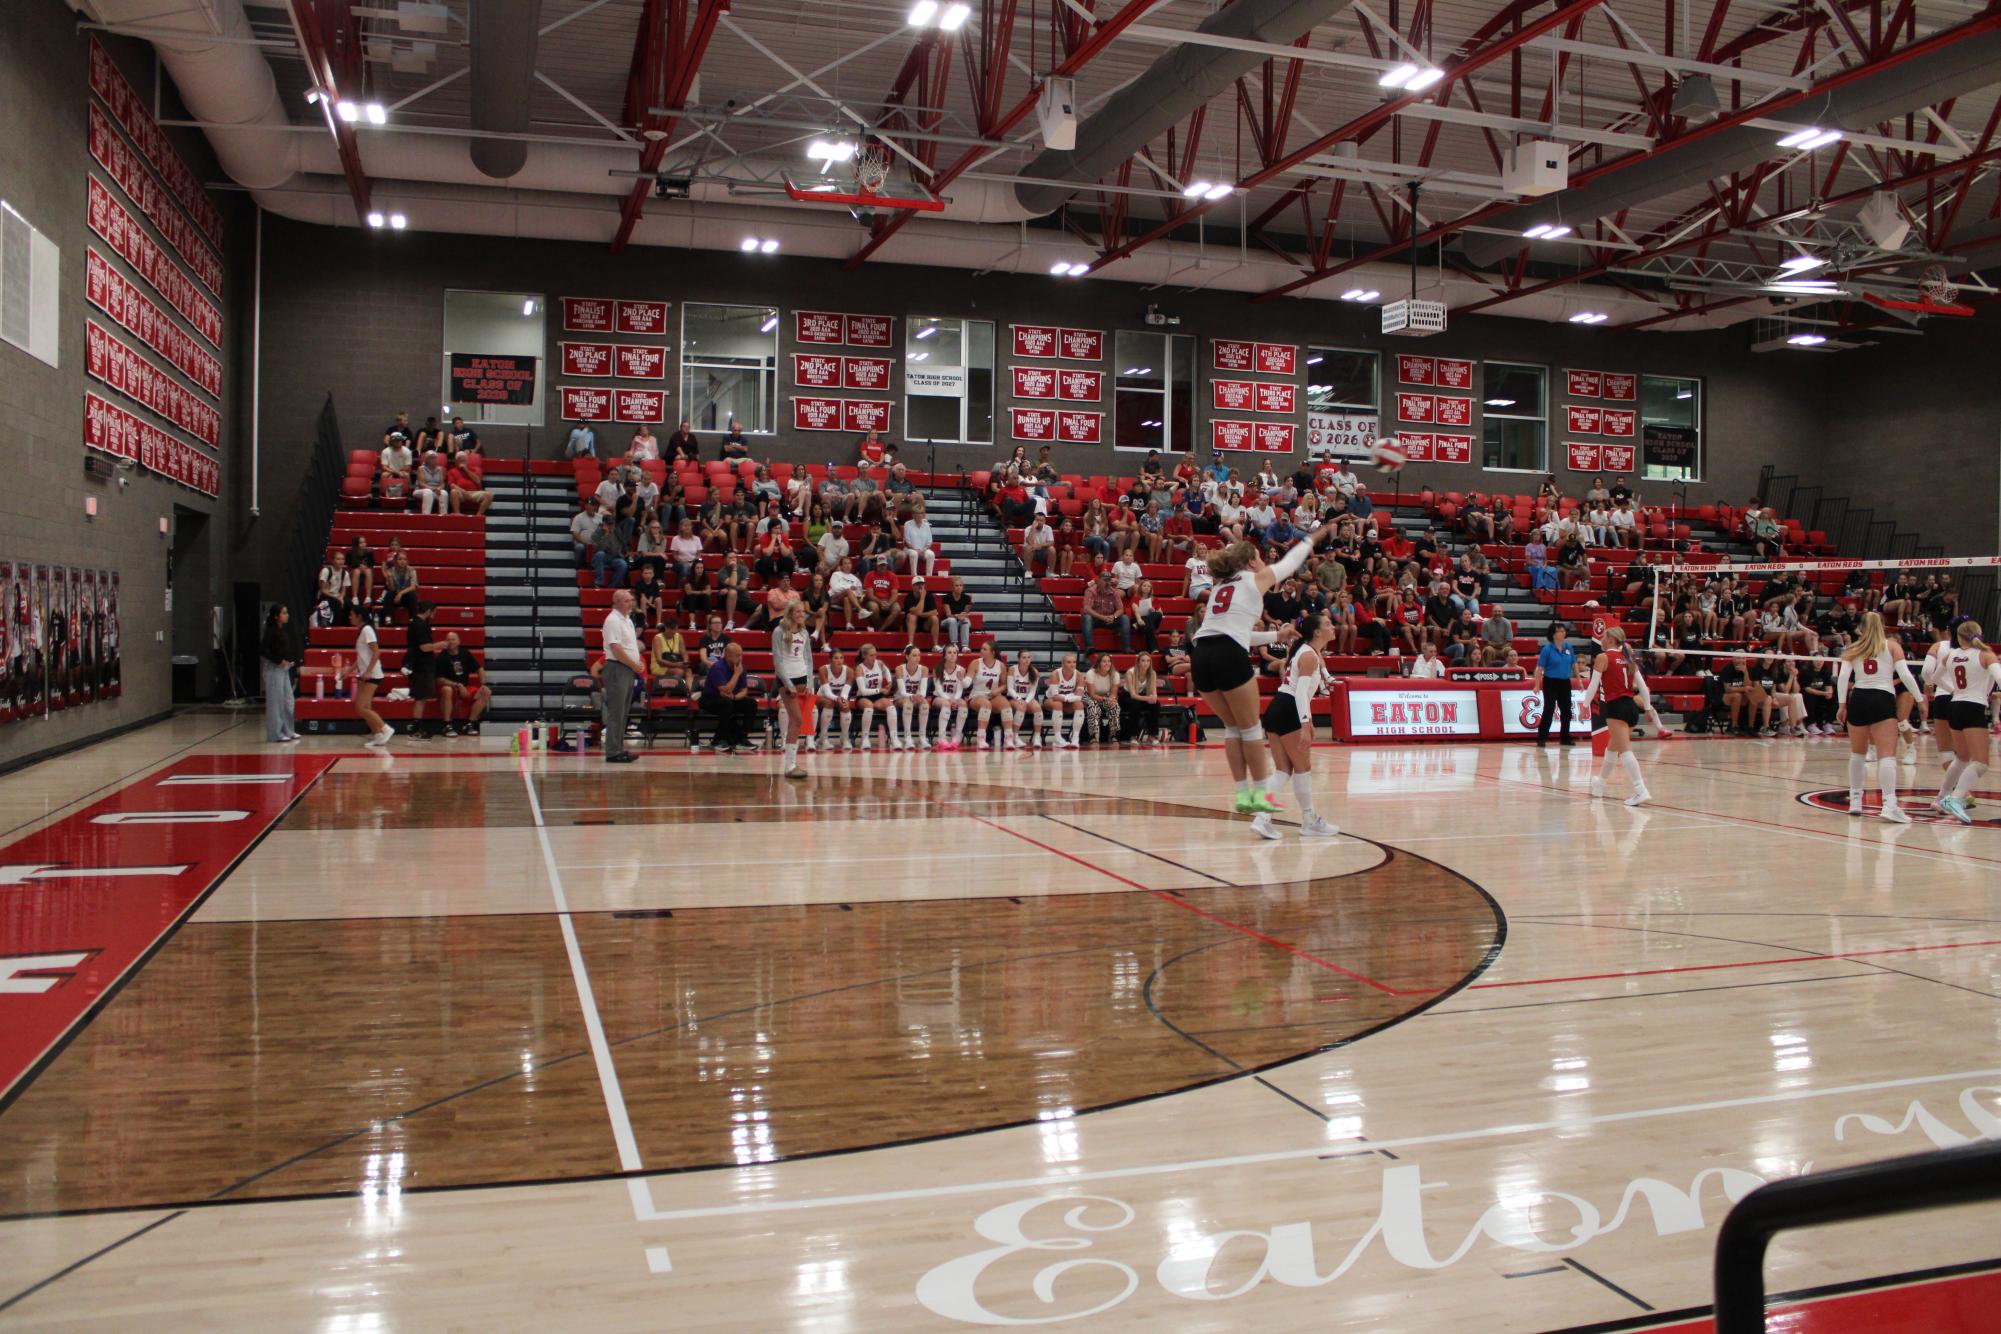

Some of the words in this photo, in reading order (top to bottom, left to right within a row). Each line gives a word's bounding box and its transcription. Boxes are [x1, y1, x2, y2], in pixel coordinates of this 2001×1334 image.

[574, 304, 604, 316] FINALIST
[623, 307, 637, 316] 2ND
[639, 309, 660, 318] PLACE
[804, 318, 816, 327] 3RD
[818, 321, 838, 329] PLACE
[852, 321, 869, 330] FINAL
[871, 323, 886, 331] FOUR
[1019, 332, 1051, 342] CHAMPIONS
[1065, 335, 1096, 345] CHAMPIONS
[570, 350, 583, 359] 2ND
[585, 351, 606, 360] PLACE
[1219, 346, 1230, 354] 2ND
[1232, 348, 1249, 357] PLACE
[1274, 352, 1290, 360] PLACE
[622, 352, 640, 360] FINAL
[642, 354, 659, 363] FOUR
[472, 359, 515, 369] EATON
[801, 361, 814, 370] 2ND
[816, 363, 836, 372] PLACE
[849, 364, 884, 374] CHAMPIONS
[1404, 360, 1431, 371] CHAMPIONS
[1441, 364, 1467, 374] CHAMPIONS
[1019, 373, 1051, 384] CHAMPIONS
[1063, 376, 1095, 386] CHAMPIONS
[1607, 379, 1631, 387] CHAMPIONS
[464, 379, 504, 389] CLASS
[507, 381, 522, 390] OF
[1219, 386, 1249, 395] CHAMPIONS
[569, 394, 587, 404] FINAL
[589, 396, 606, 405] FOUR
[621, 396, 658, 407] CHAMPIONS
[801, 405, 818, 413] FINAL
[820, 406, 836, 415] FOUR
[849, 406, 884, 417] CHAMPIONS
[1451, 404, 1465, 412] PLACE
[1018, 415, 1040, 424] RUNNER
[1063, 418, 1079, 426] FINAL
[1081, 419, 1095, 428] FOUR
[1309, 418, 1351, 431] CLASS
[1358, 422, 1376, 432] OF
[1219, 427, 1248, 436] CHAMPIONS
[1259, 429, 1289, 438] CHAMPIONS
[1327, 433, 1357, 445] 2026
[1402, 438, 1429, 447] CHAMPIONS
[1438, 440, 1453, 448] FINAL
[1572, 448, 1597, 457] CHAMPIONS
[1213, 586, 1234, 614] 9
[1863, 658, 1877, 675] 6
[1955, 666, 1967, 689] 8
[868, 679, 878, 688] 15
[986, 679, 993, 689] 4
[1371, 702, 1457, 724] EATON
[1412, 726, 1455, 734] SCHOOL
[915, 1163, 1812, 1326] Eaton
